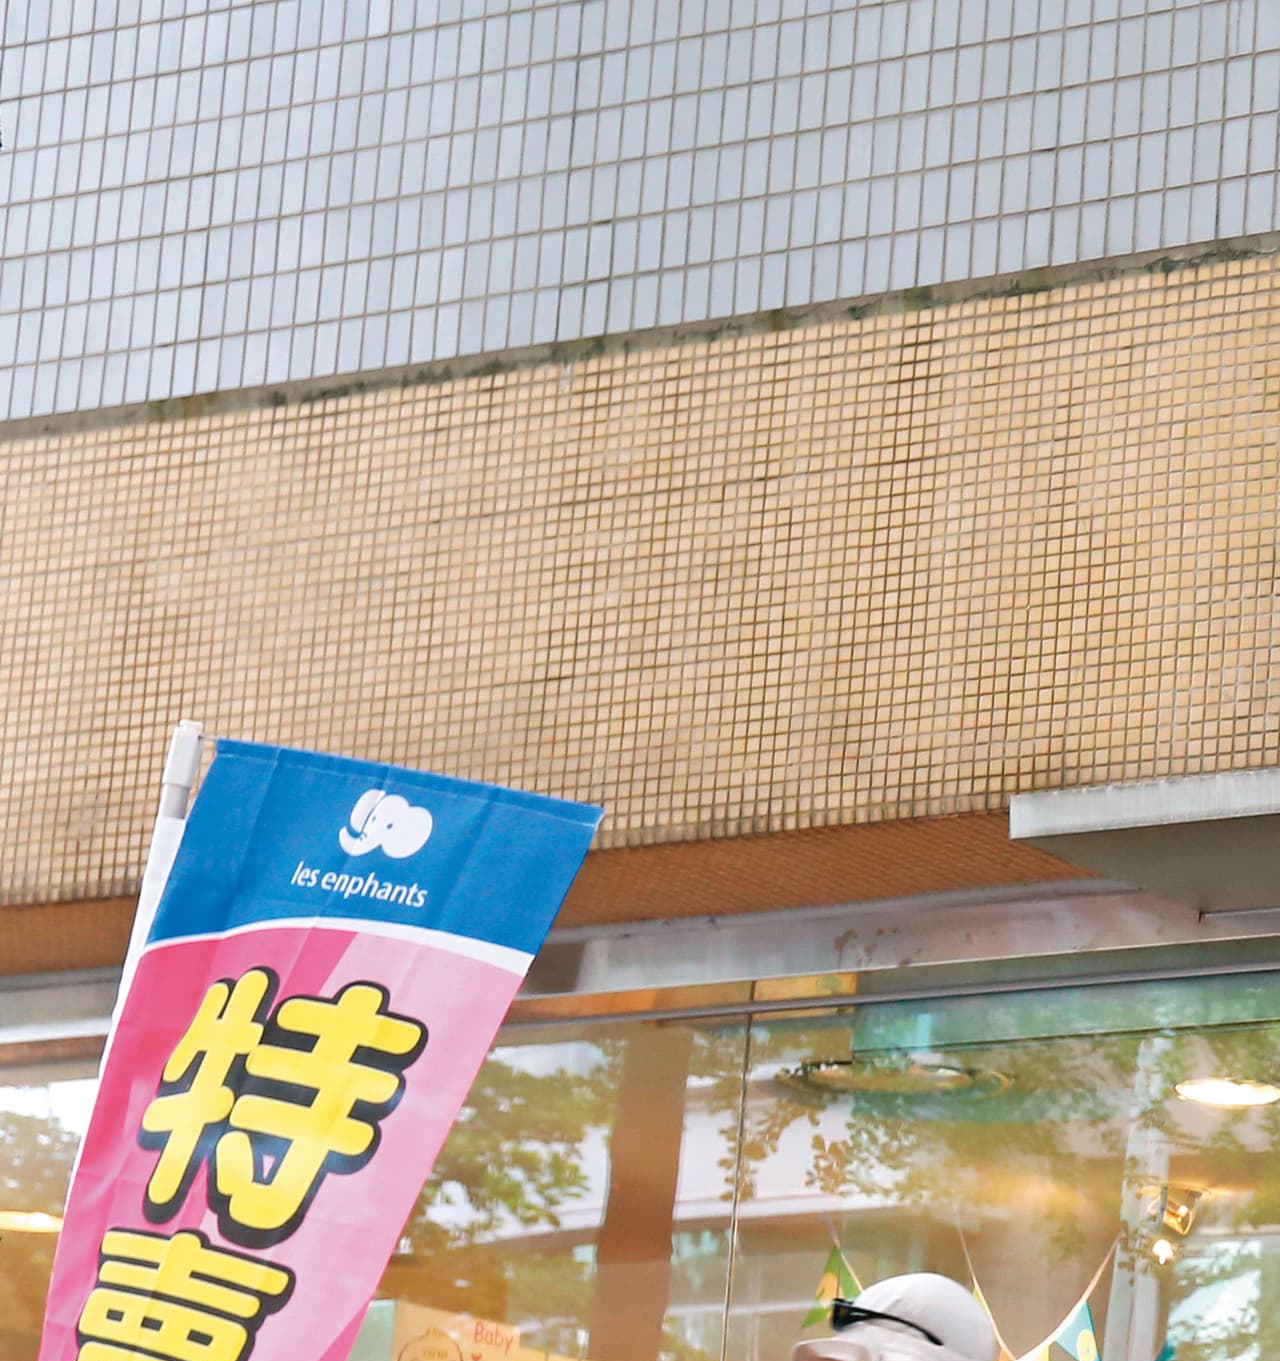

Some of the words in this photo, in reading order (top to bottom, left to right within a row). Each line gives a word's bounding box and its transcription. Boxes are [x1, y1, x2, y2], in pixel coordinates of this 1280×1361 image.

[291, 860, 319, 889] les
[320, 871, 427, 908] enphants
[473, 1322, 514, 1354] Baby
